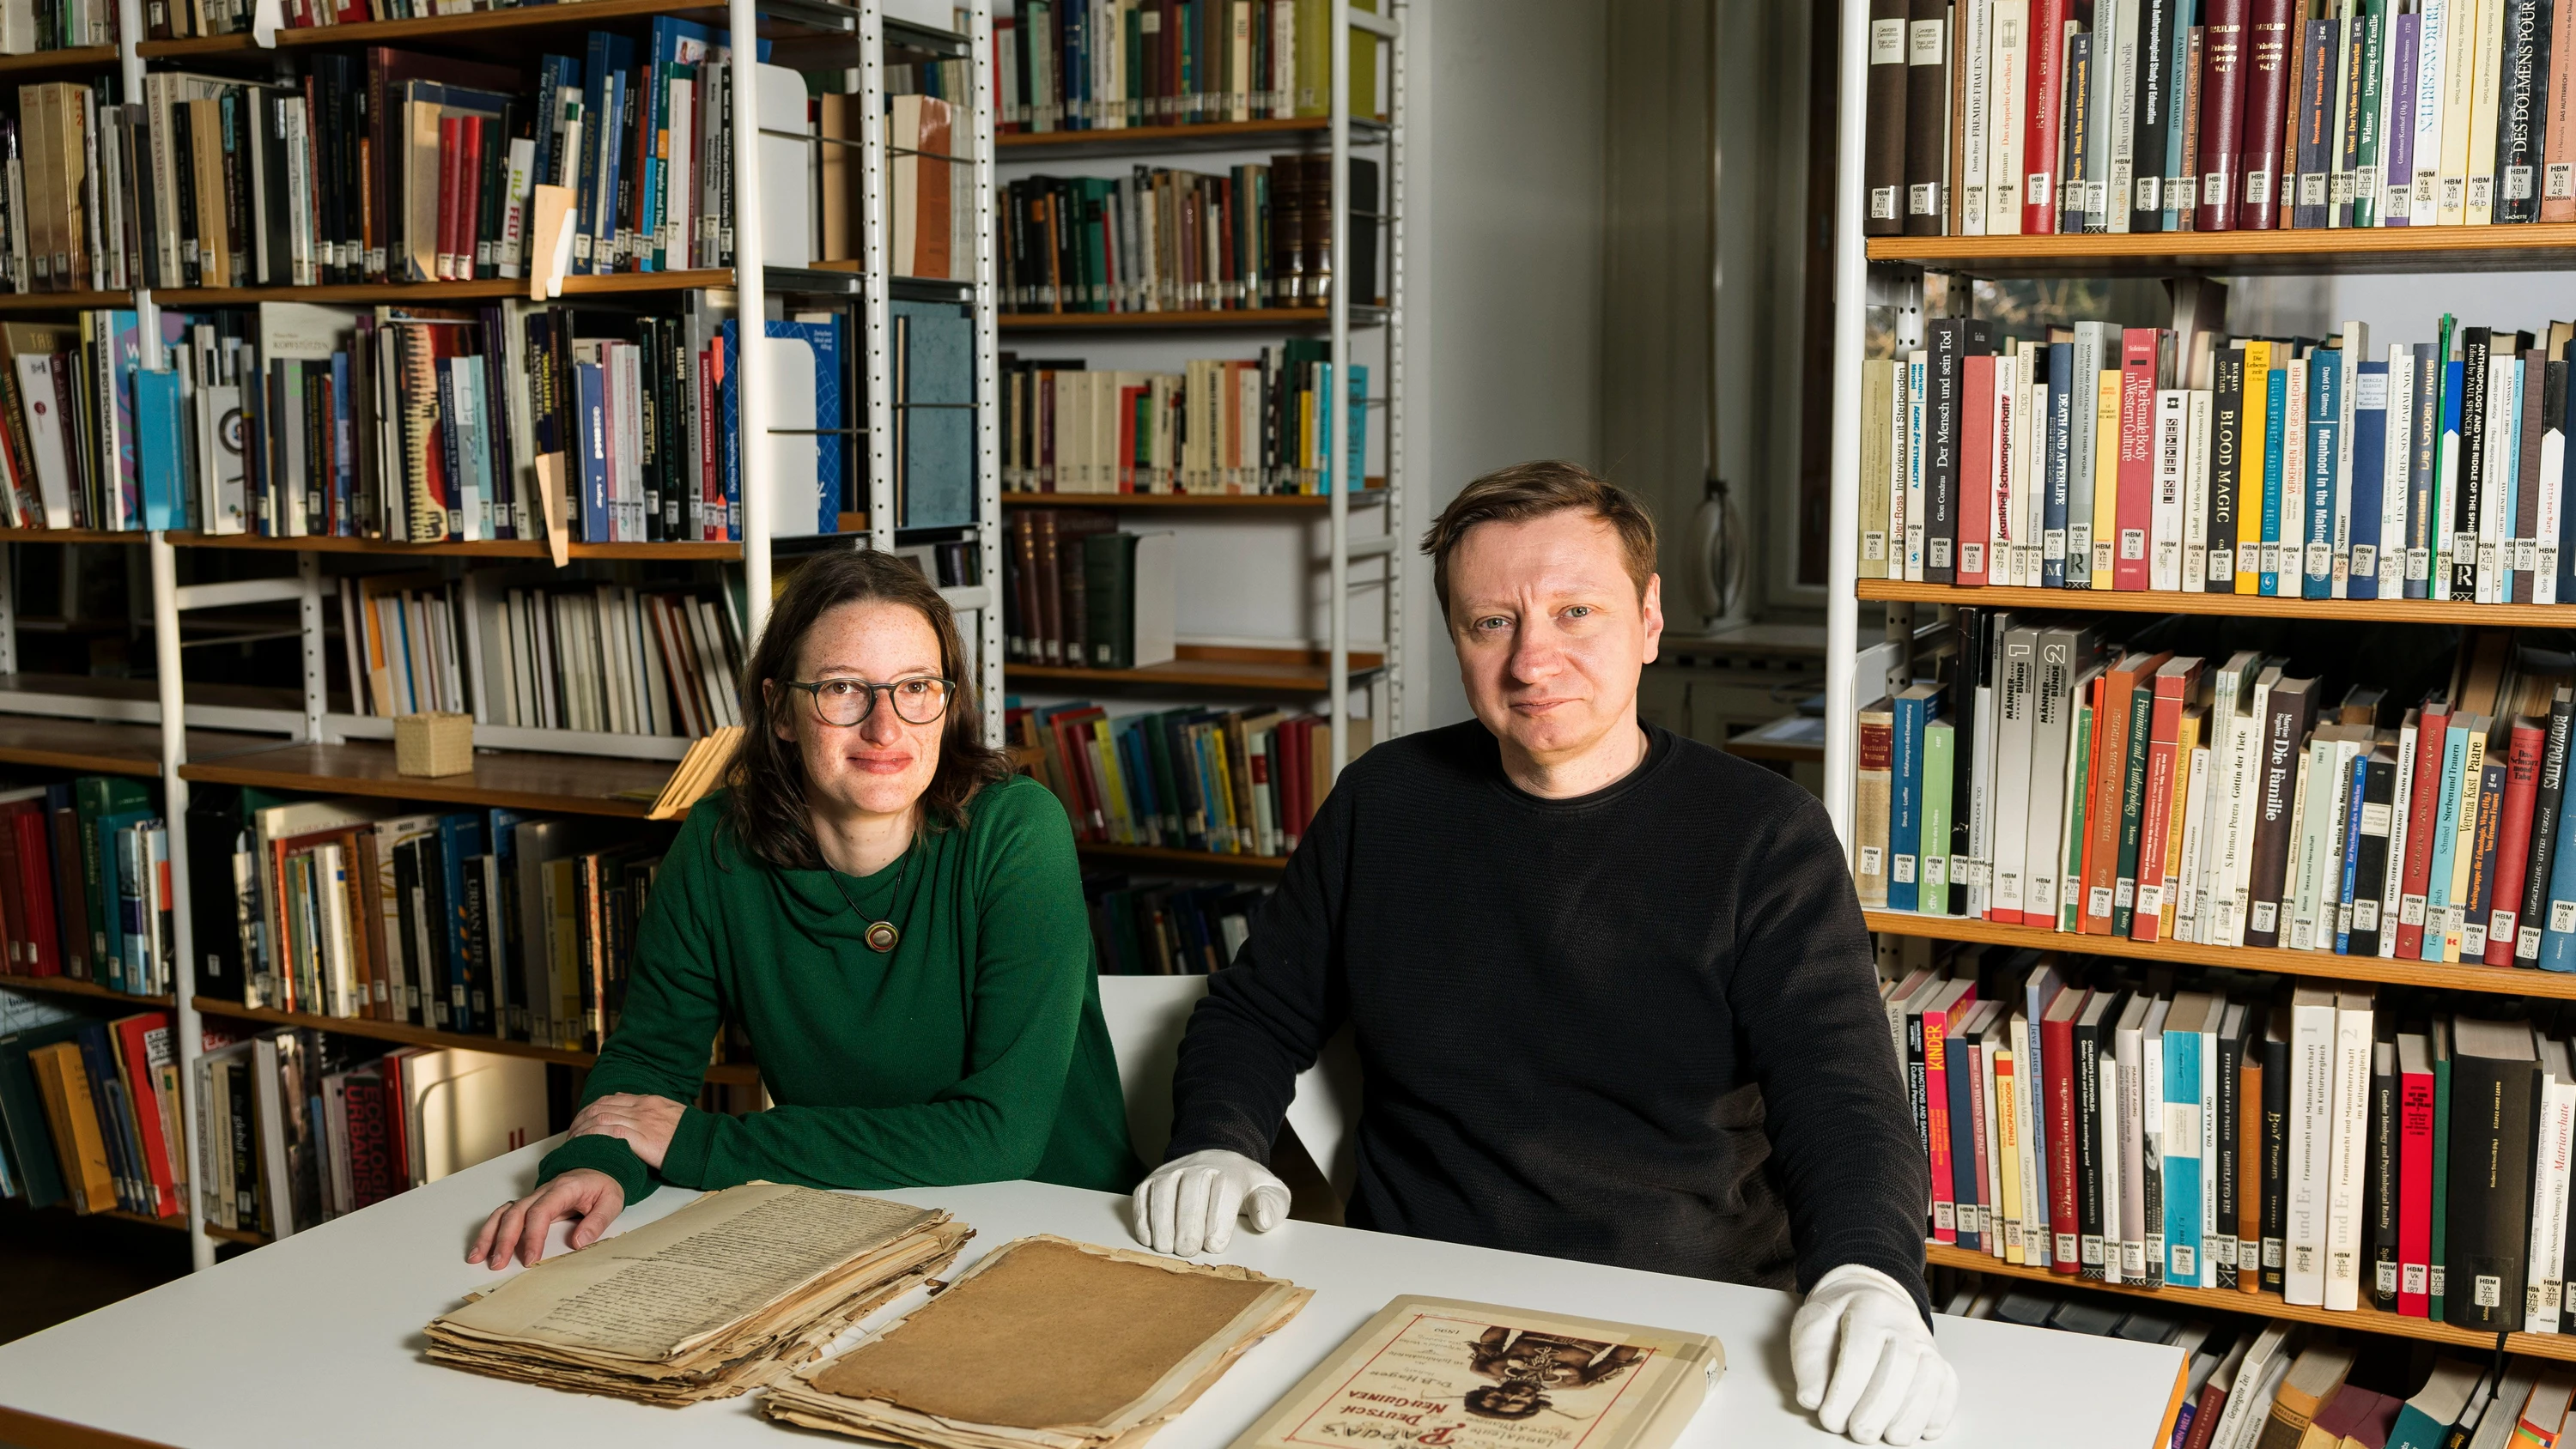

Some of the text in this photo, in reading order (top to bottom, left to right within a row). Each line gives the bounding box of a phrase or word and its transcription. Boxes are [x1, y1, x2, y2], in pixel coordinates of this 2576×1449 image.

[2149, 9, 2161, 59] Anthropological
[2120, 43, 2132, 115] Körpersymbolik
[2148, 60, 2159, 82] Study
[2362, 14, 2379, 144] Widmer Ursprung der Familie
[2517, 48, 2531, 120] DOLMENS
[1972, 55, 1982, 136] FREMDE FRAUEN
[2002, 99, 2011, 130] doppelte
[2147, 91, 2157, 124] Education
[2173, 89, 2182, 130] MARRIAGE
[2119, 136, 2128, 156] Tabu
[2513, 124, 2527, 153] DES
[1940, 330, 1952, 353] Tod
[2469, 344, 2477, 364] Edited
[676, 347, 685, 379] BATIK
[1940, 355, 1951, 375] sein
[2322, 367, 2330, 385] David
[2466, 365, 2476, 376] by
[2475, 343, 2486, 414] ANTHROPOLOGY
[1897, 367, 1905, 422] Sterbenden
[1940, 378, 1950, 399] und
[2291, 367, 2300, 426] GESCHLECHTER
[2320, 393, 2329, 417] Gilmore
[1938, 402, 1949, 444] Mensch
[2122, 372, 2138, 461] in Western Culture
[2132, 378, 2152, 462] The Female Body
[2464, 397, 2473, 436] SPENCER
[1937, 446, 1948, 468] Der
[2055, 393, 2068, 505] DEATH AND AFTERLIFE
[2163, 418, 2178, 503] LES FEMMES
[2216, 410, 2233, 522] BLOOD MAGIC
[2318, 429, 2330, 475] Manhood
[2287, 451, 2296, 494] VERKEHREN
[2317, 477, 2329, 488] in
[2470, 458, 2480, 487] RIDDLE
[2470, 488, 2478, 496] OF
[1997, 490, 2008, 539] Krankheit
[2316, 489, 2328, 506] the
[2009, 645, 2030, 656] 1
[2044, 645, 2066, 664] 2
[2004, 678, 2014, 719] MÄNNER
[2014, 662, 2024, 694] BÜNDE
[2050, 664, 2060, 697] BÜNDE
[2039, 682, 2050, 724] MÄNNER
[2128, 698, 2148, 817] Feminism and Anthropology
[2232, 771, 2242, 799] Göttin
[2237, 731, 2246, 752] Tiefe
[2266, 740, 2290, 822] Die Familie
[2339, 761, 2349, 805] Menstruation
[2443, 744, 2459, 822] Sterben und Trauern
[2459, 742, 2482, 833] Verena Kast Paare
[1926, 1023, 1945, 1070] KINDER
[2318, 1045, 2326, 1115] im Kulturvergleich
[2380, 1114, 2390, 1144] Ideology
[2554, 1104, 2568, 1171] Matriarchate
[2303, 1133, 2312, 1180] Frauenmacht
[2380, 1159, 2390, 1203] Psychological
[2380, 1203, 2389, 1229] Reality
[2227, 1374, 2251, 1419] Gespiegelte Zeit
